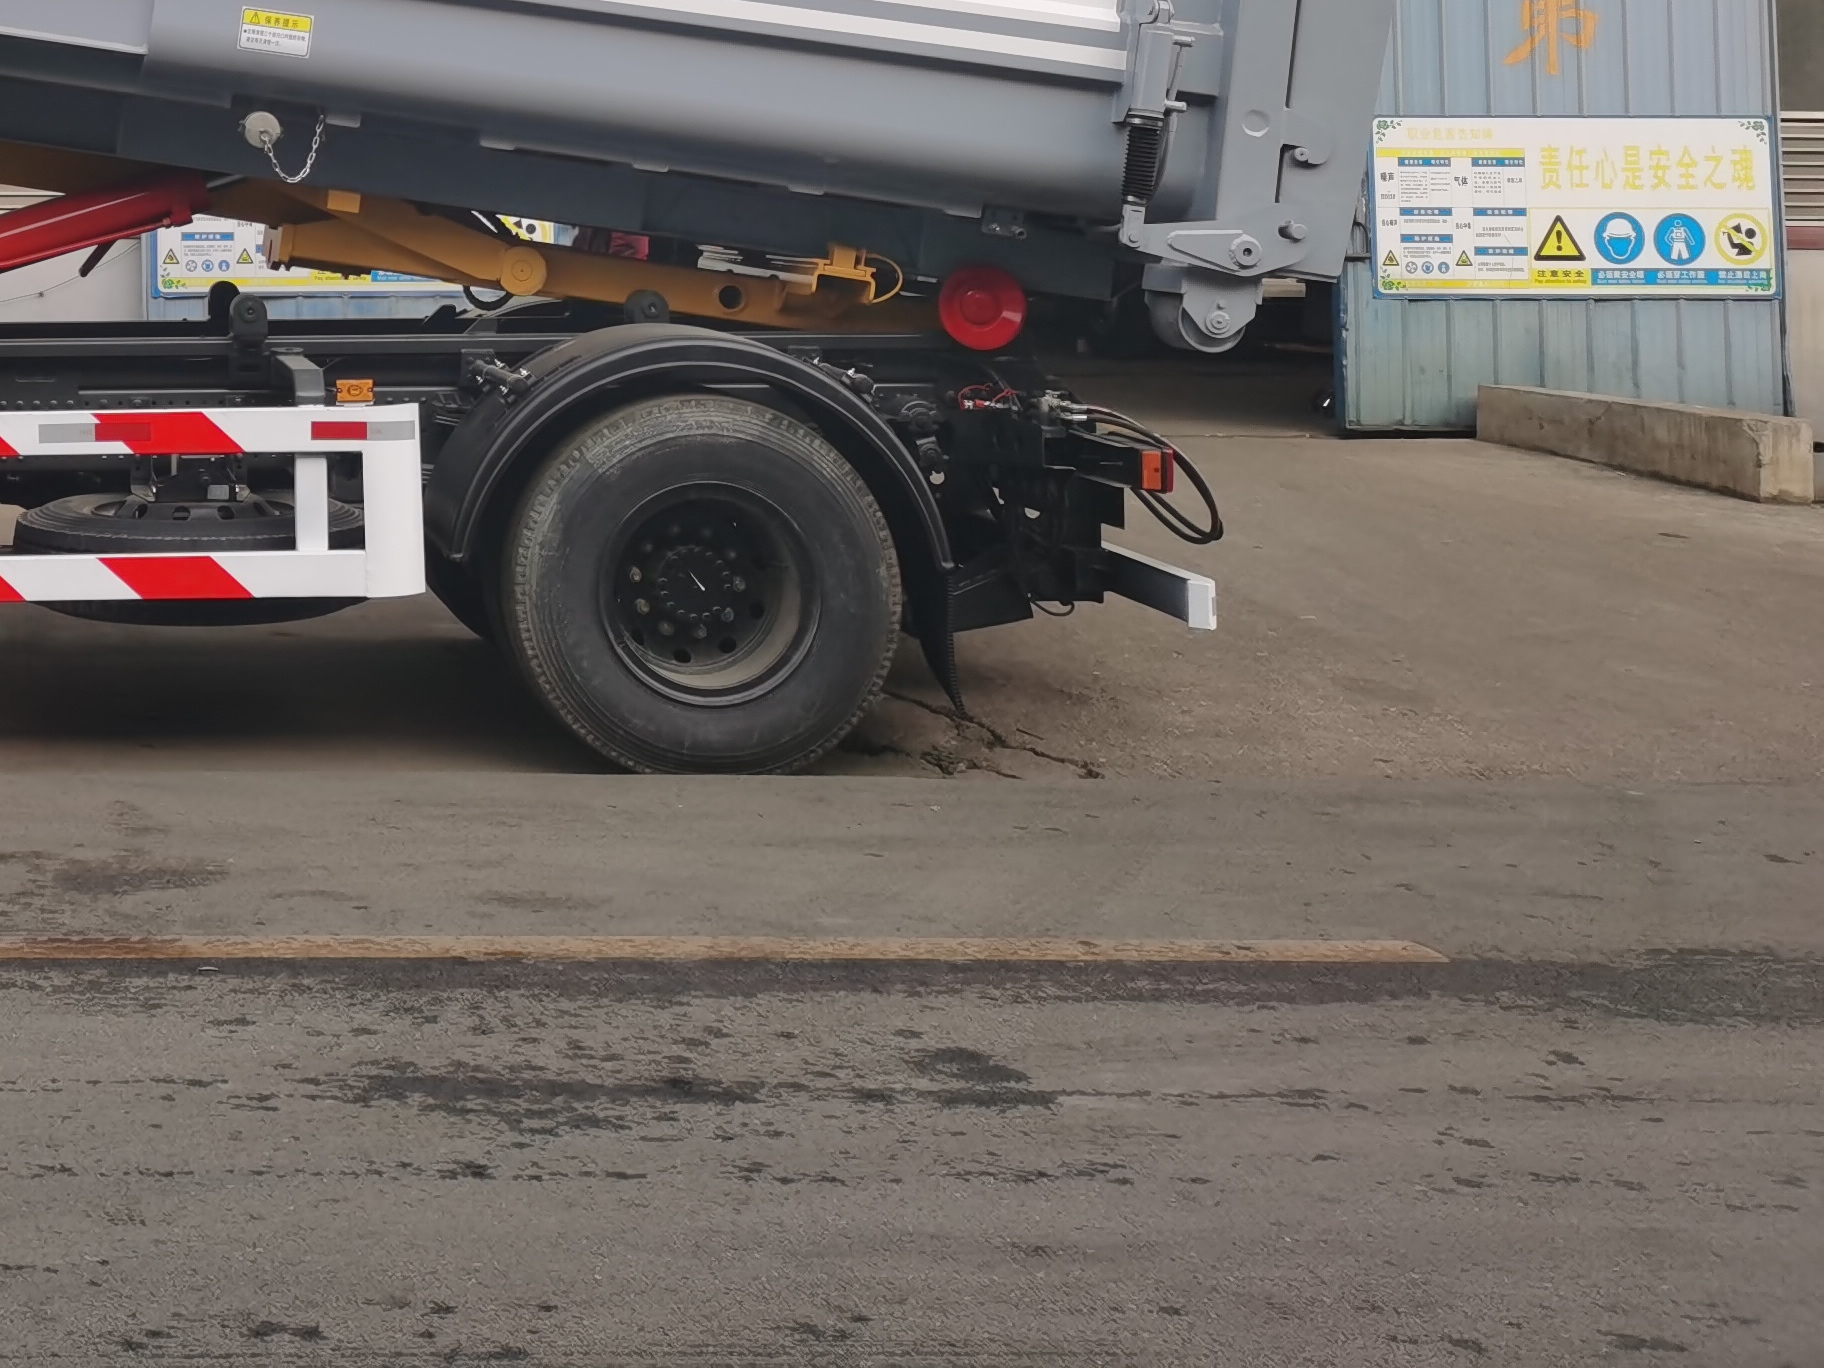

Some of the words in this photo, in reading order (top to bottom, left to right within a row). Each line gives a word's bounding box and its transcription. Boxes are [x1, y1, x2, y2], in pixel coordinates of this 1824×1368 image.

[264, 15, 299, 29] 保养提示
[1538, 144, 1756, 192] 责任心是安全之魂
[1453, 175, 1469, 187] 气体
[1536, 269, 1585, 278] 注意安全
